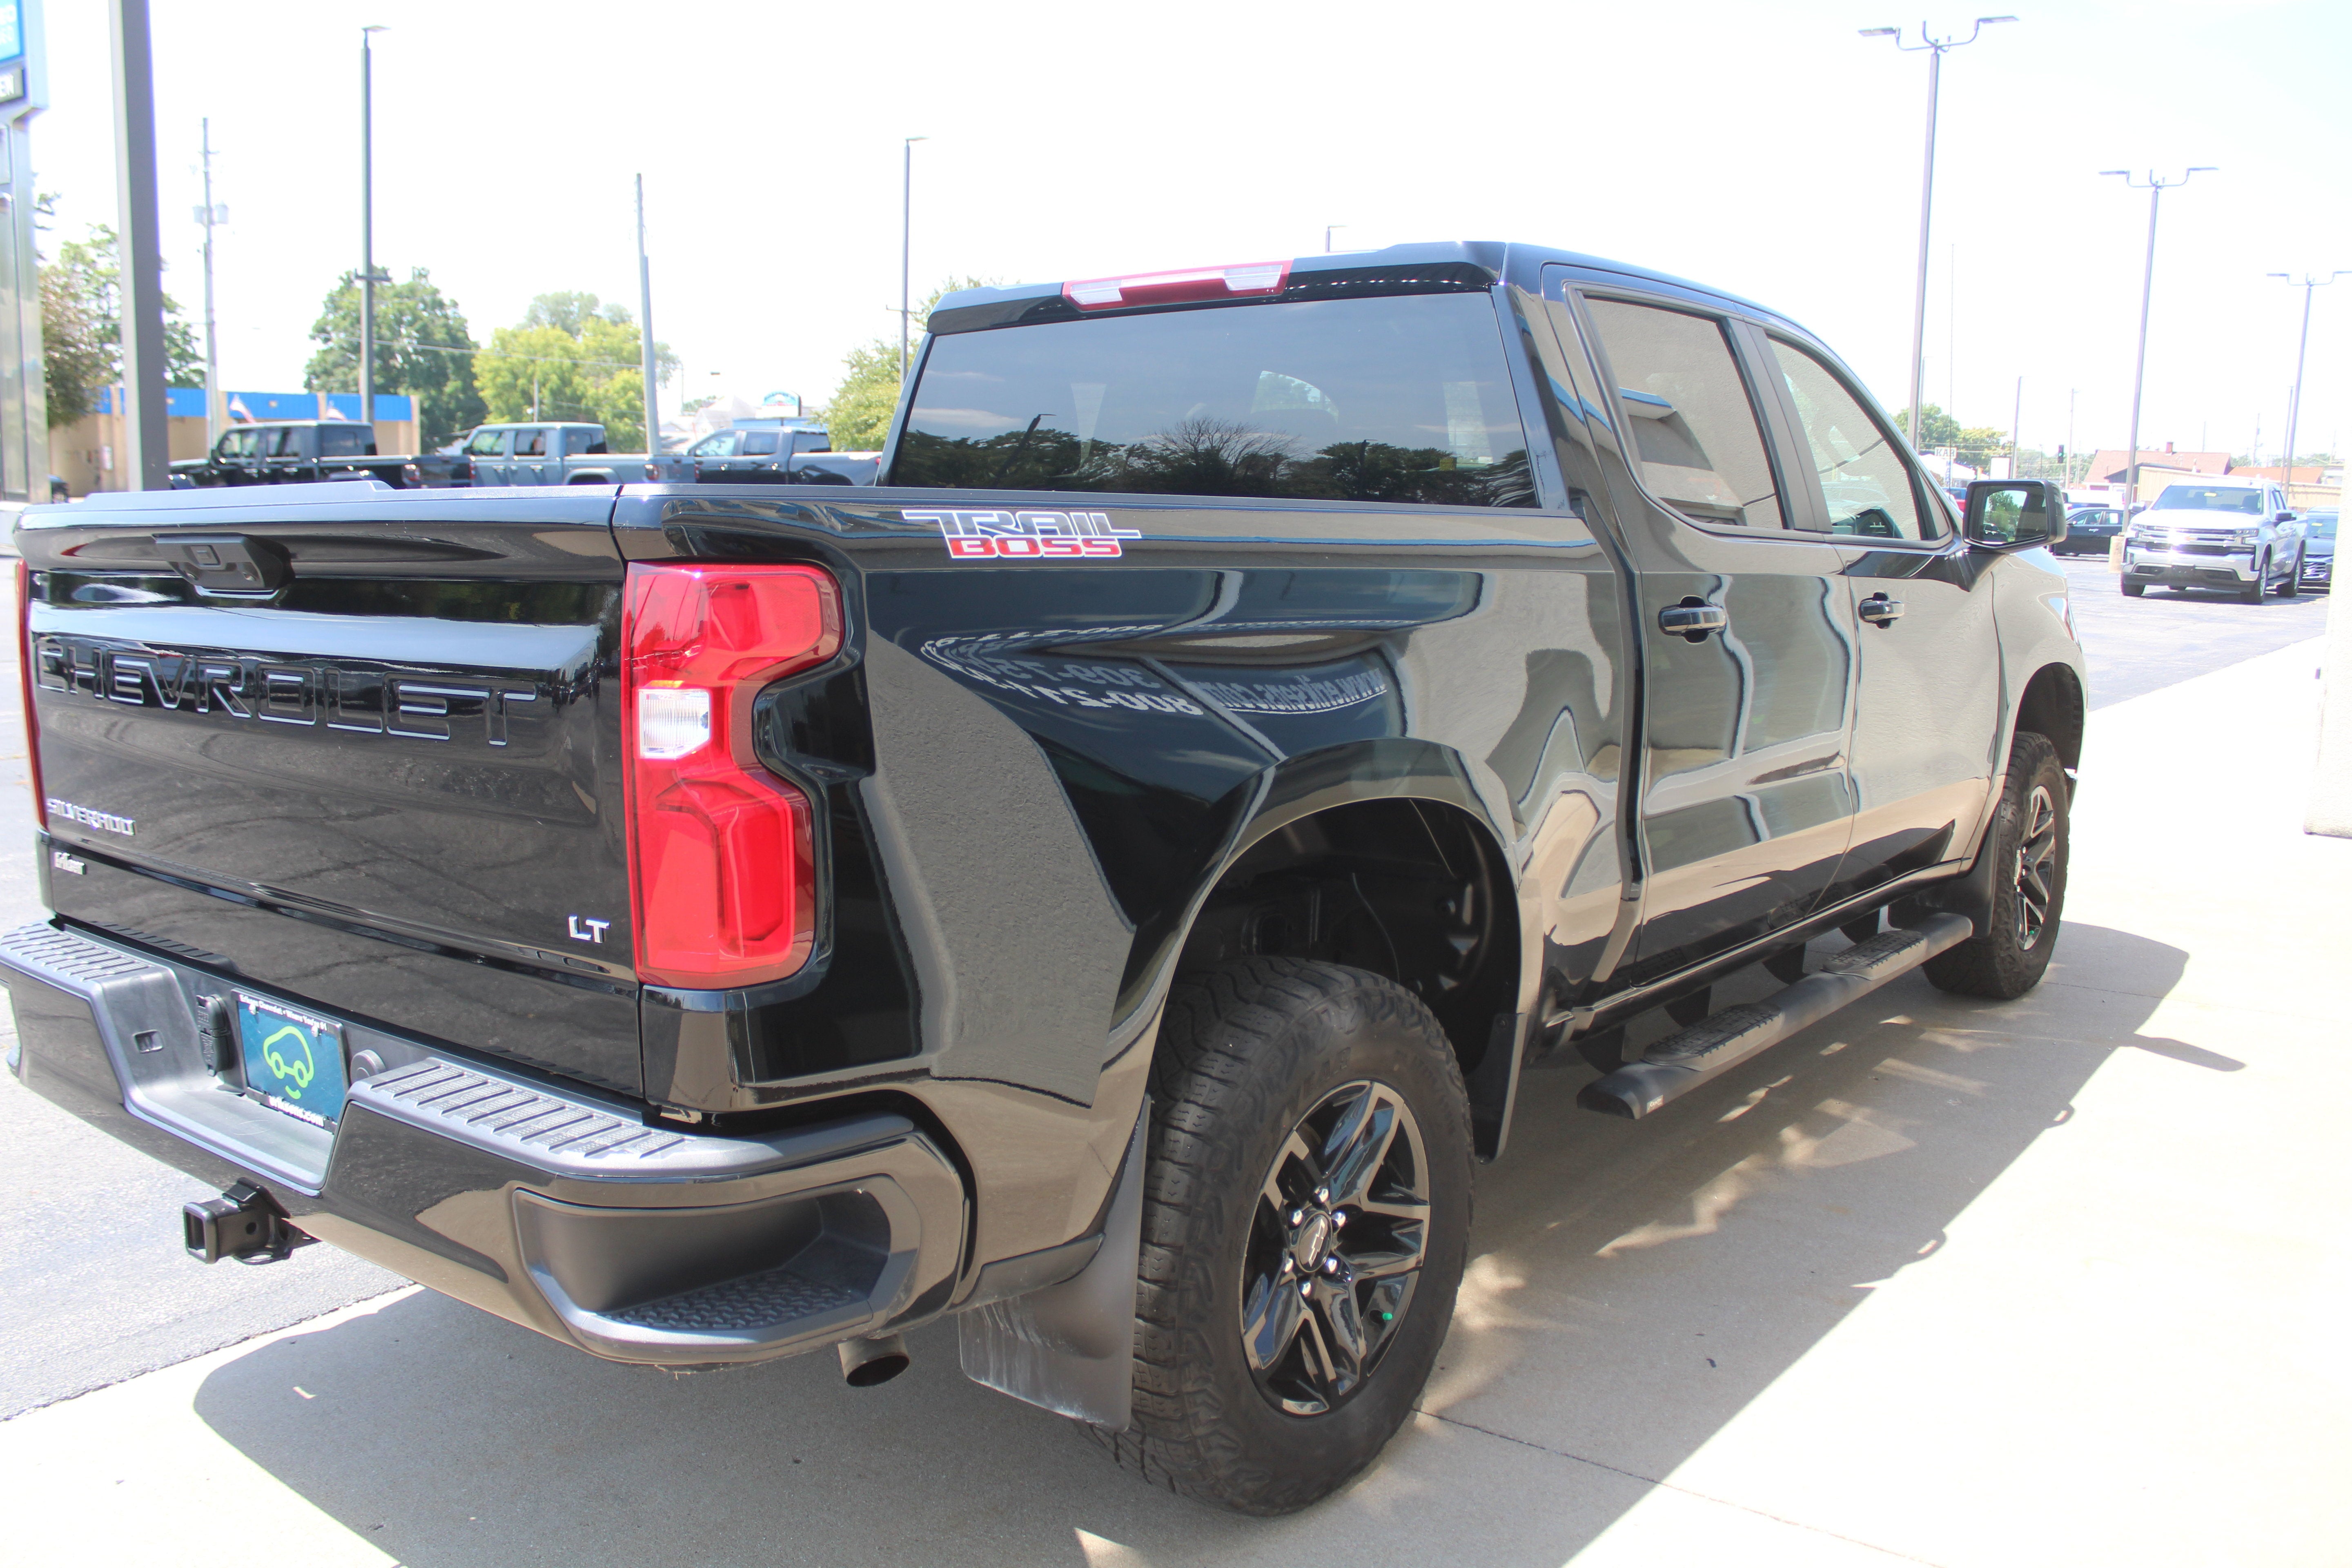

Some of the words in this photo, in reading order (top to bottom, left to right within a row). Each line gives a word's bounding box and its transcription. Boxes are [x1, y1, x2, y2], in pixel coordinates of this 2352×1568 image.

[1936, 448, 1955, 457] KAR
[901, 510, 1142, 538] TRAIL
[946, 535, 1122, 559] BOSS
[37, 637, 536, 746] CHEVROLET
[46, 798, 136, 836] SILVERADO
[568, 916, 610, 943] LT
